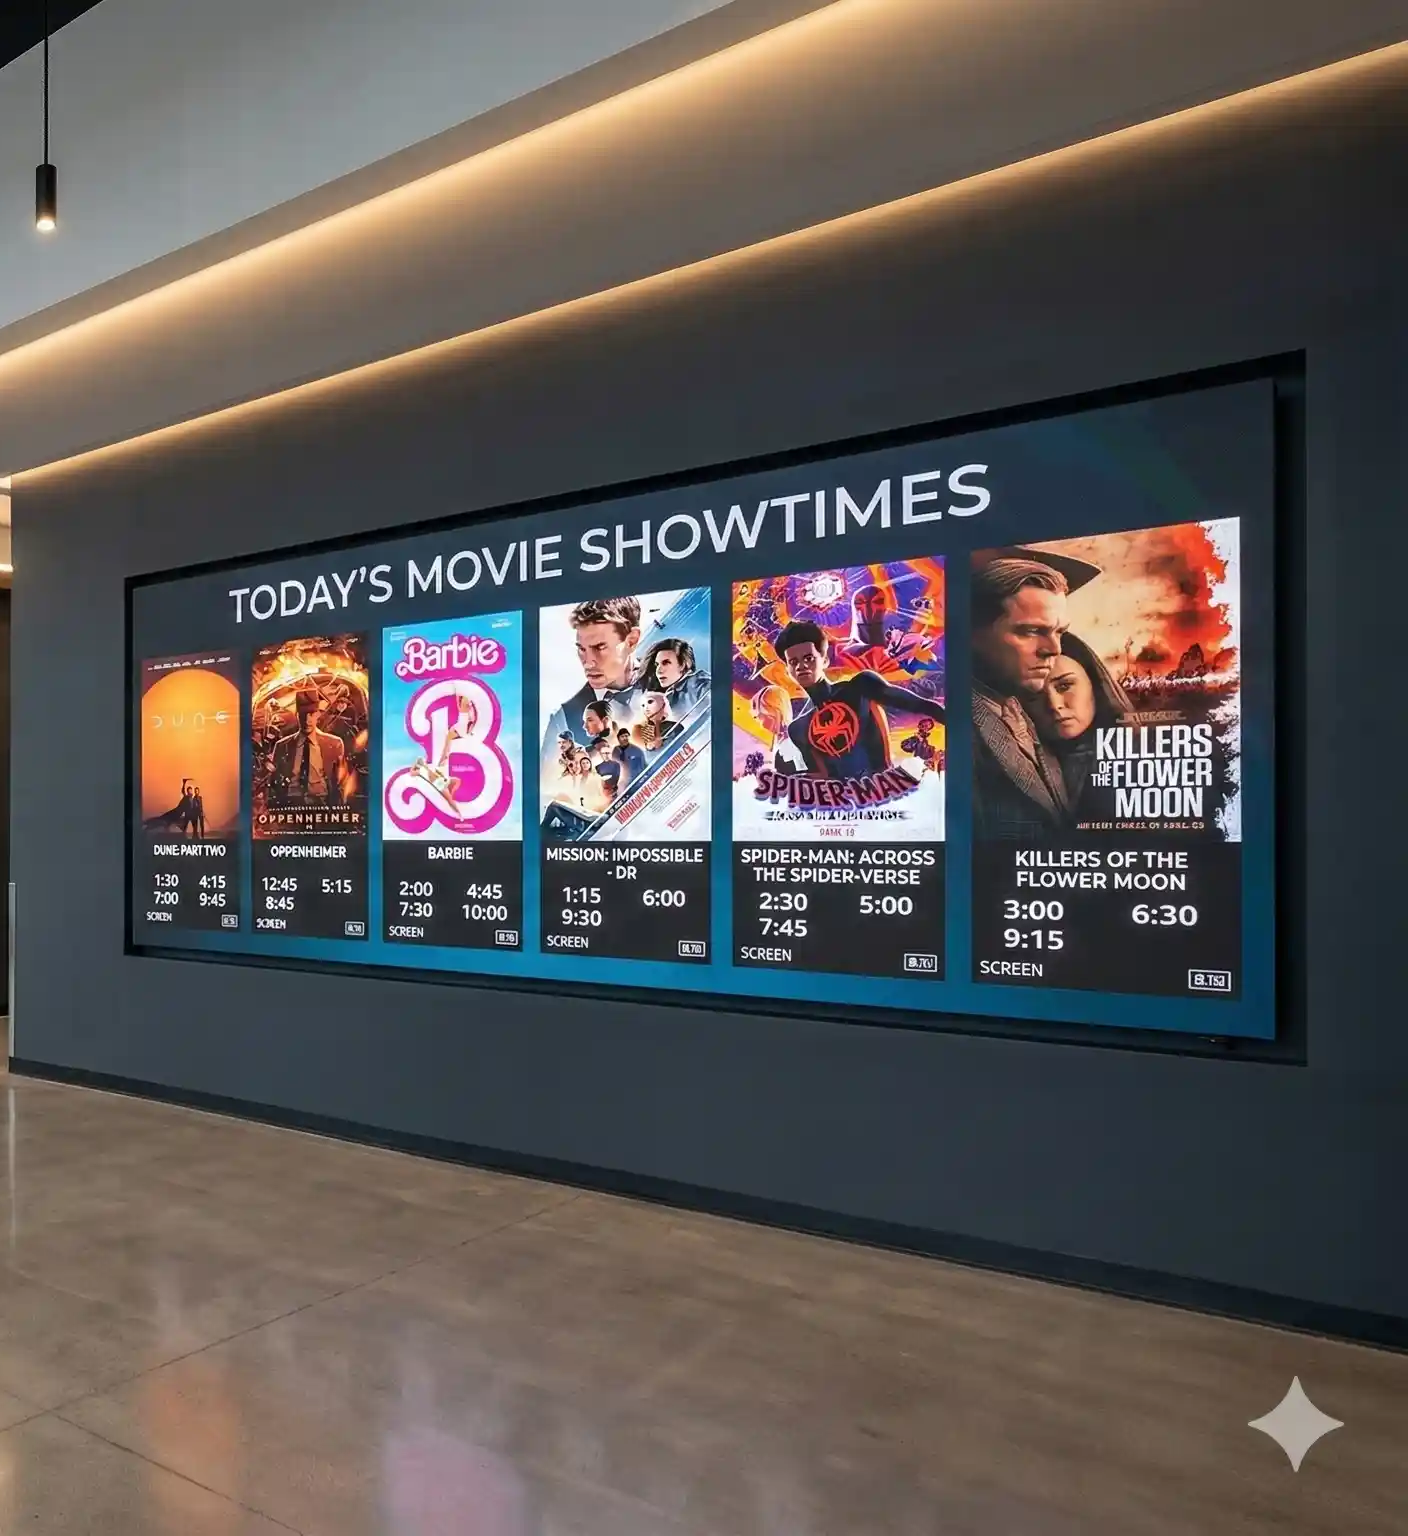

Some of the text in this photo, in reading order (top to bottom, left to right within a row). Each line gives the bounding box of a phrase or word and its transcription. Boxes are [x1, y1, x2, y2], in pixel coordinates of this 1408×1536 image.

[229, 463, 992, 623] TODAY'S MOVIE SHOWTIMES
[396, 635, 499, 677] Barbie
[1096, 724, 1213, 760] KILLERS
[1098, 761, 1113, 774] OF
[1112, 758, 1213, 787] FLOWER
[1091, 773, 1112, 787] THE
[1115, 786, 1204, 818] MOON
[180, 845, 202, 856] PART
[203, 845, 226, 857] TWO
[270, 845, 347, 859] OPPENHEIMER
[427, 846, 474, 860] BARBIE
[546, 848, 703, 863] MISSION: IMPOSSIBLE
[740, 849, 936, 866] SPIDER-MAN: ACROSS
[1015, 850, 1189, 869] KILLERS OF THE
[154, 874, 226, 889] 1:30 4:15
[616, 865, 637, 880] DR
[753, 867, 921, 885] THE SPIDER-VERSE
[1016, 871, 1186, 891] FLOWER MOON
[262, 877, 352, 893] 12:45 5:15
[399, 881, 503, 899] 2:00 4:45
[153, 891, 226, 907] 7:00 9:45
[265, 896, 295, 911] 8:45
[562, 886, 686, 907] 1:15 6:00
[759, 892, 913, 915] 2:30 5:00
[399, 901, 508, 921] 7:30 10:00
[561, 909, 602, 927] 9:30
[1004, 899, 1198, 926] 3:00 6:30
[388, 925, 424, 938] SCREEN
[758, 917, 808, 937] 7:45
[546, 935, 589, 949] SCREEN
[1003, 928, 1064, 950] 9:15
[740, 946, 792, 962] SCREEN
[980, 960, 1043, 978] SCREEN
